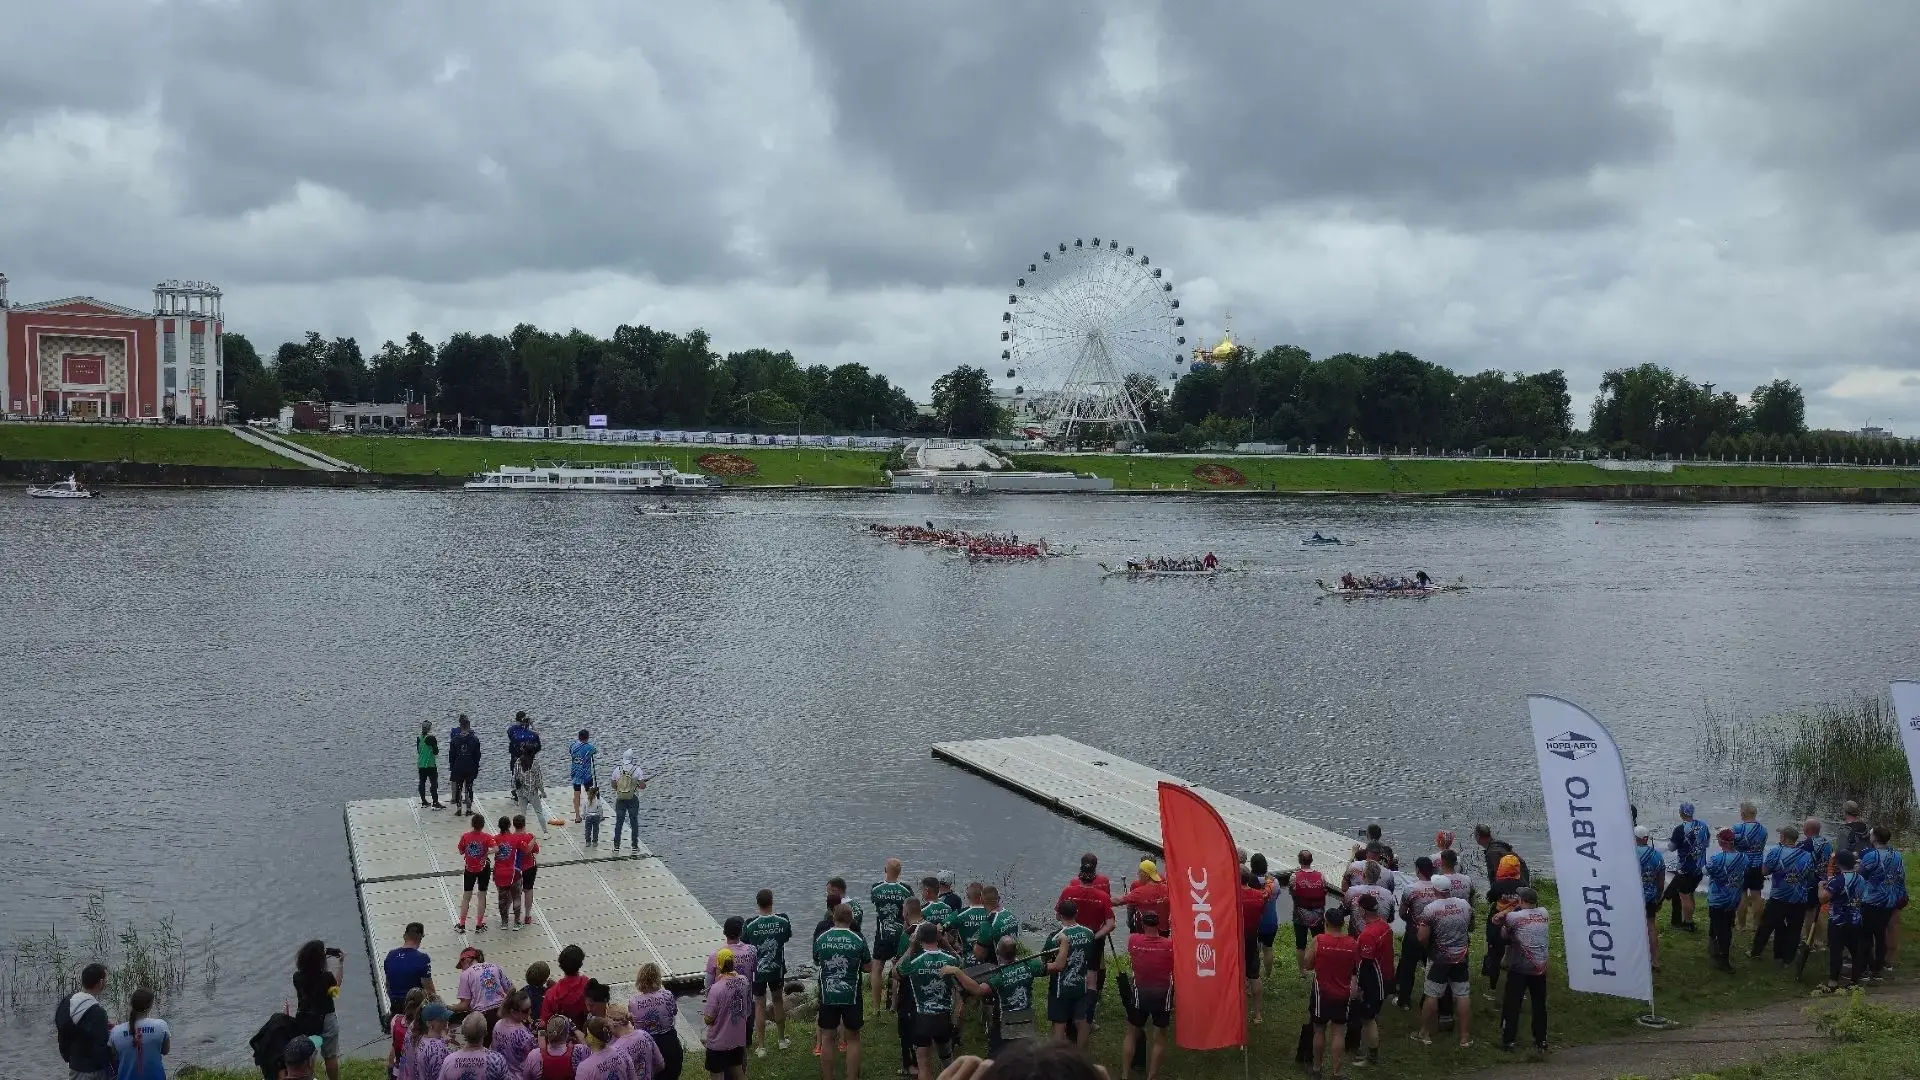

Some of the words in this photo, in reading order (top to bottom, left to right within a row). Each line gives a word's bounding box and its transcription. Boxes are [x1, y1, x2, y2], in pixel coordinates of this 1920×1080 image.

[1546, 742, 1597, 750] НОРД-АВТО
[1187, 866, 1214, 939] DKC
[753, 927, 784, 936] DRAGON
[821, 942, 857, 950] DRAGON
